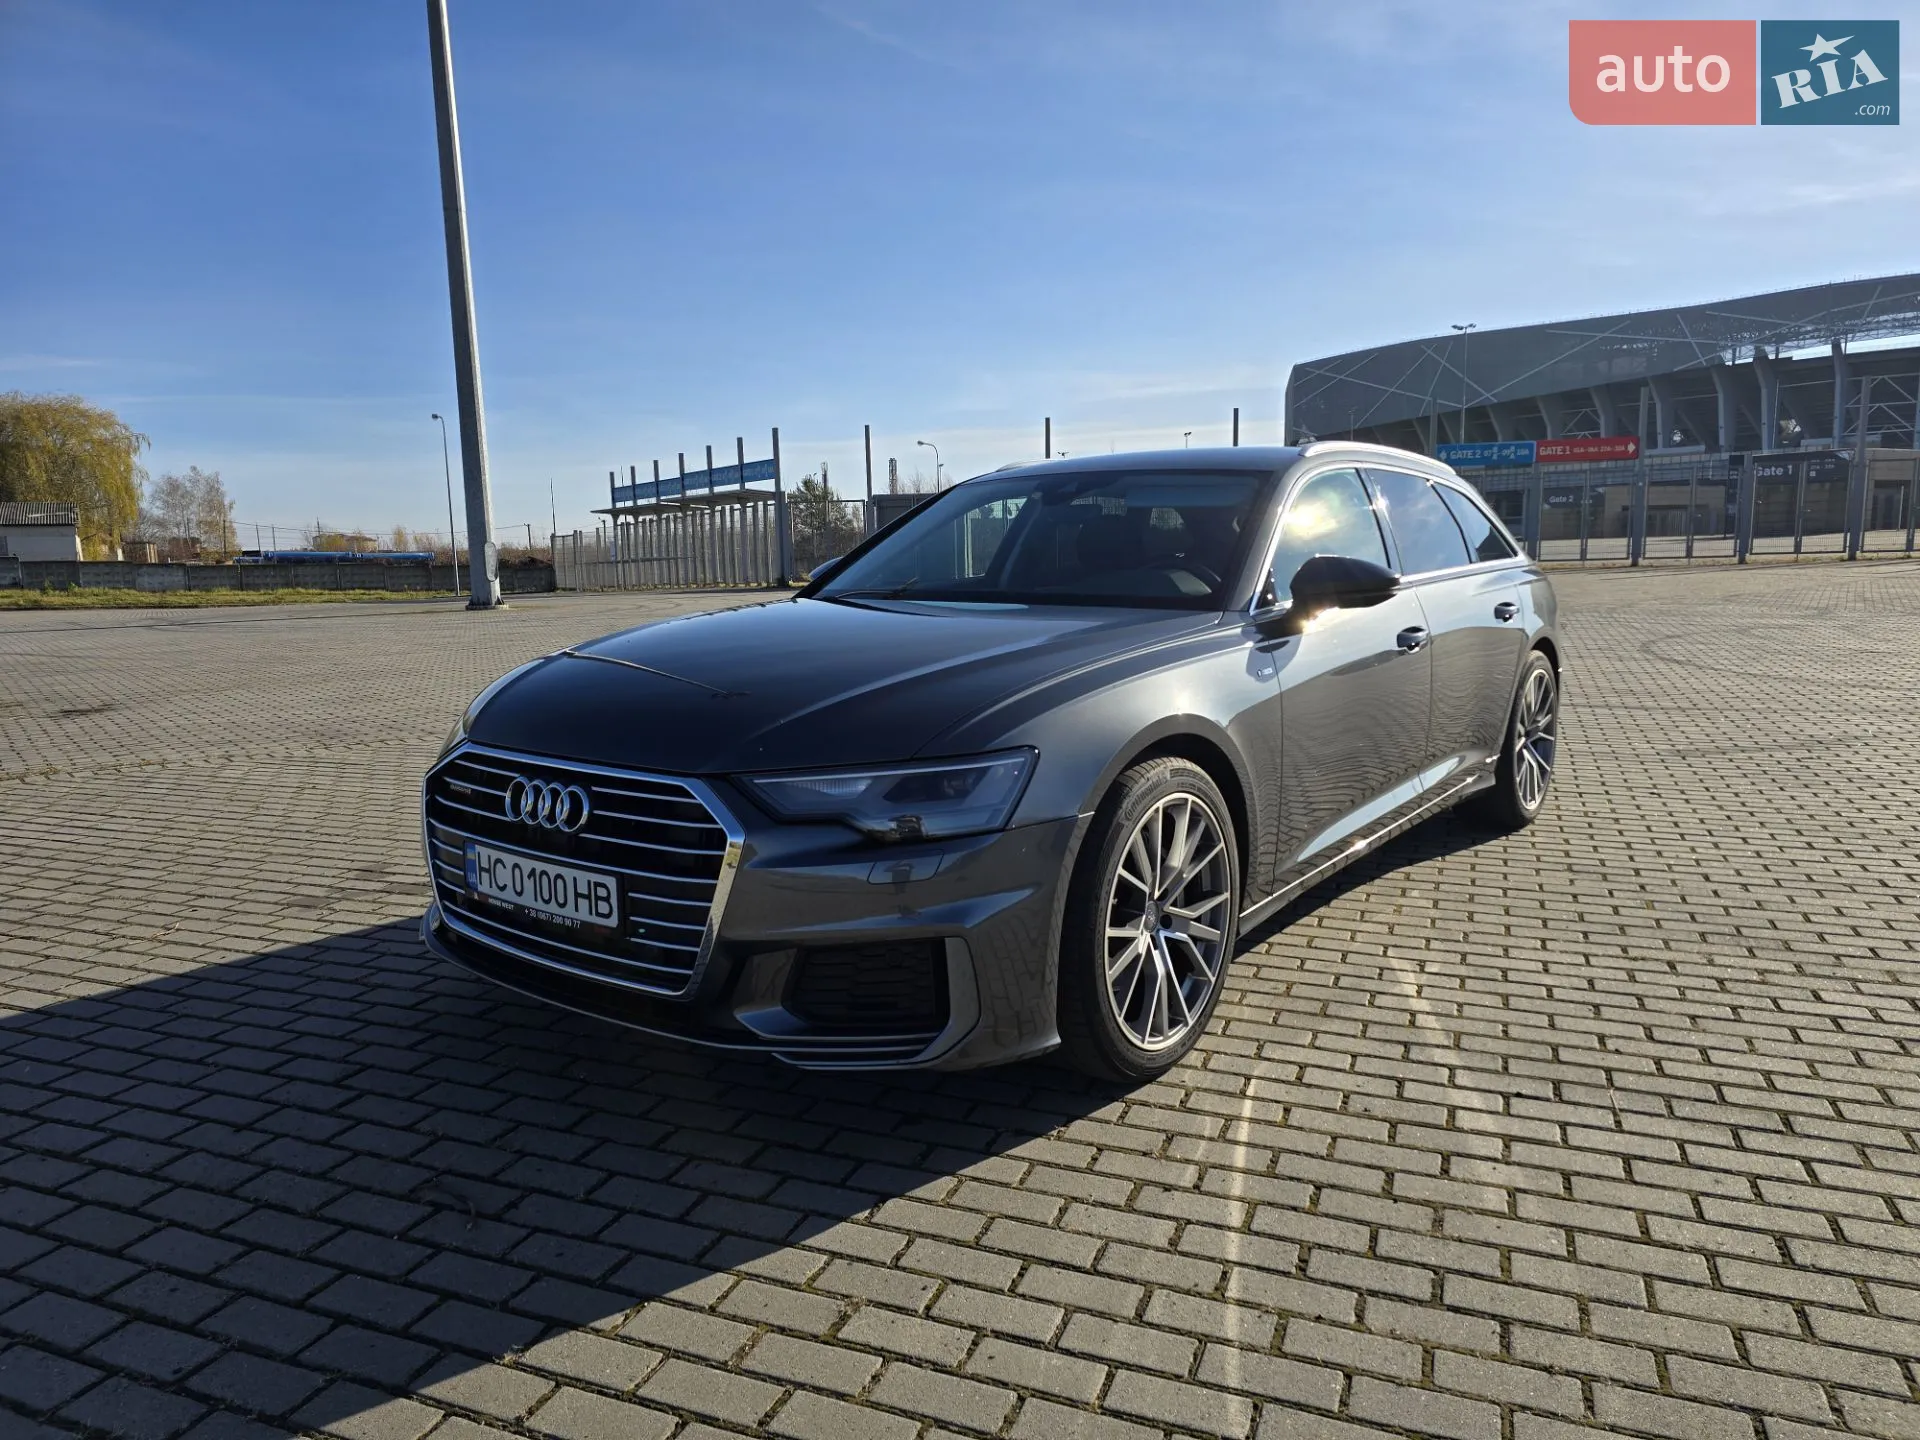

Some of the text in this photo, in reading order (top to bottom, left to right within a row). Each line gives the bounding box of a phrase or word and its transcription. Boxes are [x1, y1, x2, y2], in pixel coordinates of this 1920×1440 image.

[1449, 450, 1475, 460] GATE
[1475, 450, 1481, 458] 2
[1539, 446, 1564, 456] GATE
[1757, 465, 1793, 477] Gate 1
[1549, 495, 1567, 503] Gate
[478, 851, 614, 920] HC 0100 HB
